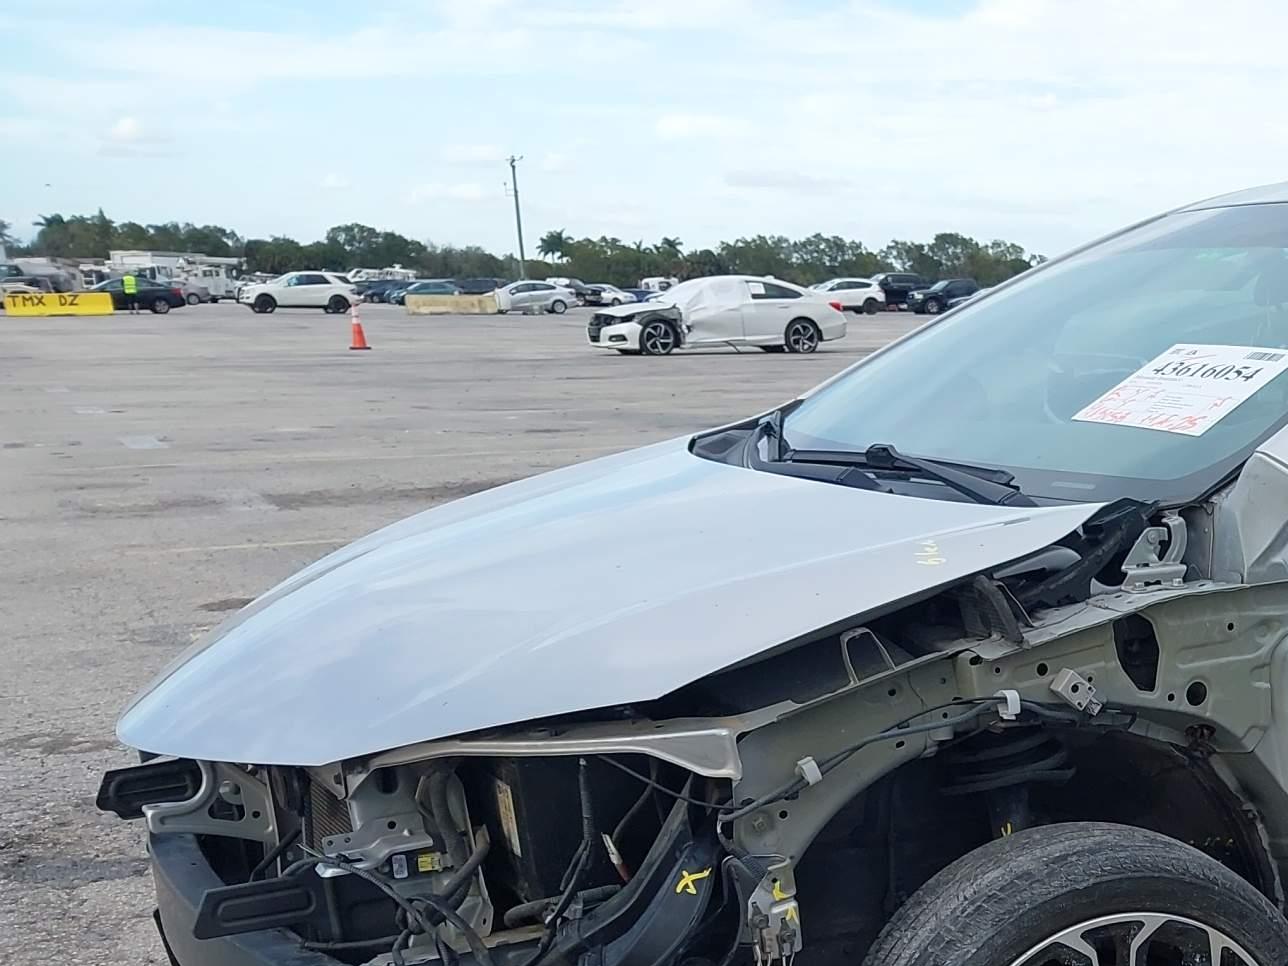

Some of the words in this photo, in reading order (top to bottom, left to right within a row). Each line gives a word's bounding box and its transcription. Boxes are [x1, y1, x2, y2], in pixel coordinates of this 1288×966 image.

[7, 294, 46, 308] TMX
[58, 294, 80, 306] DZ
[1153, 361, 1265, 382] 43616054
